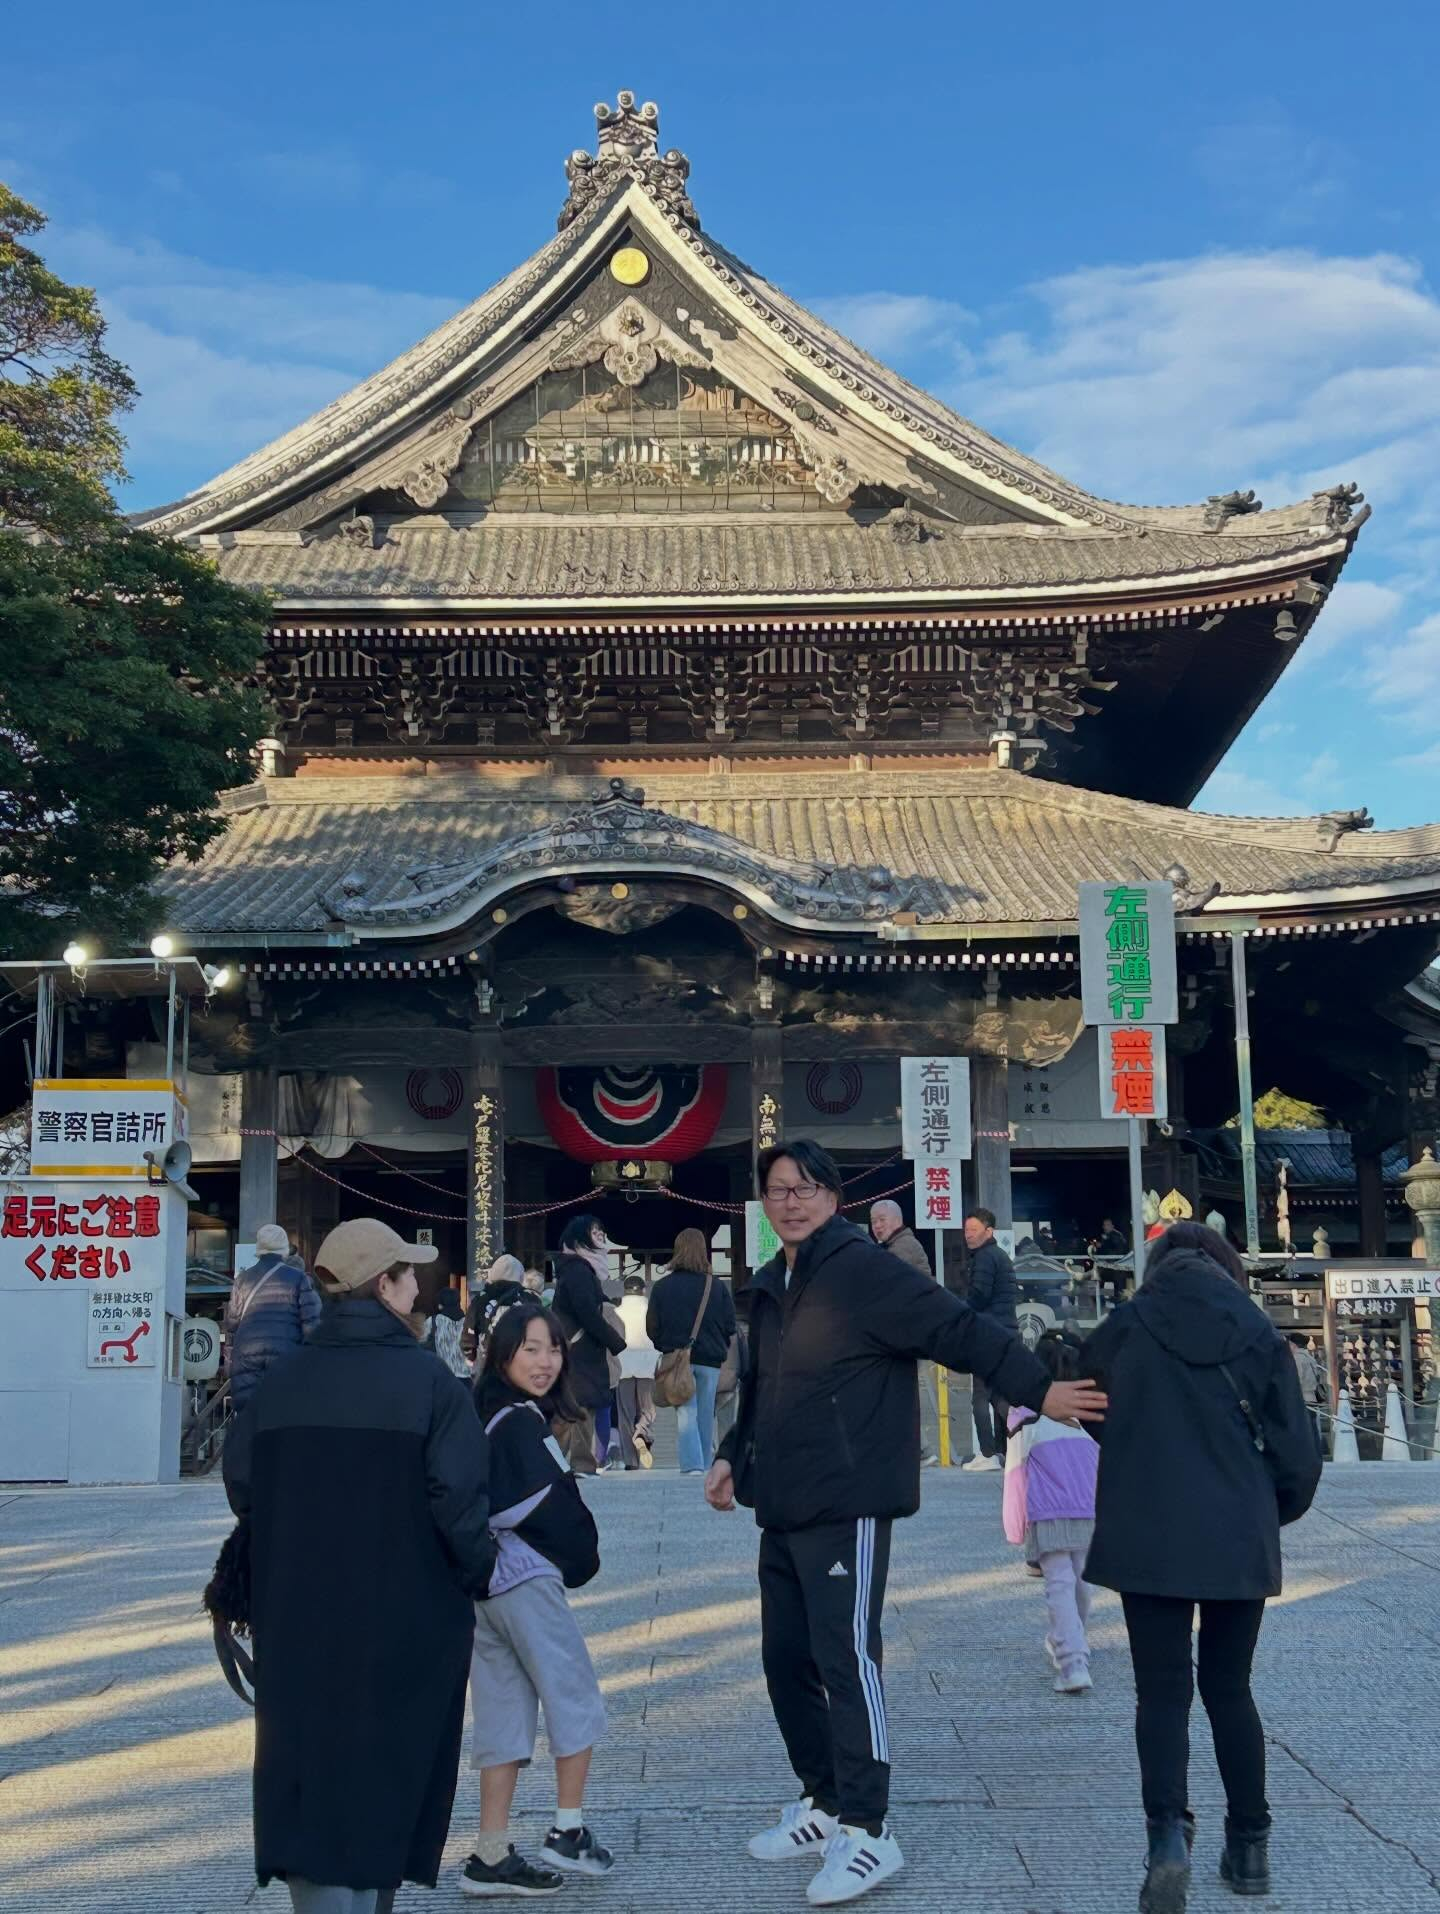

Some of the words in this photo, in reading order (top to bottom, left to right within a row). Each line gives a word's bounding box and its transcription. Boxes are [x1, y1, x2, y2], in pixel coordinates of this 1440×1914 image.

[1104, 886, 1152, 1020] 左側通行
[1110, 1029, 1154, 1114] 禁煙
[37, 1111, 166, 1143] 警察官詰所
[920, 1062, 952, 1154] 左側通行
[1, 1194, 160, 1239] 足元にご注意
[926, 1167, 952, 1221] 禁煙
[25, 1244, 131, 1281] ください
[1335, 1278, 1431, 1294] 出口進入禁止
[92, 1307, 152, 1319] の方向へ帰る
